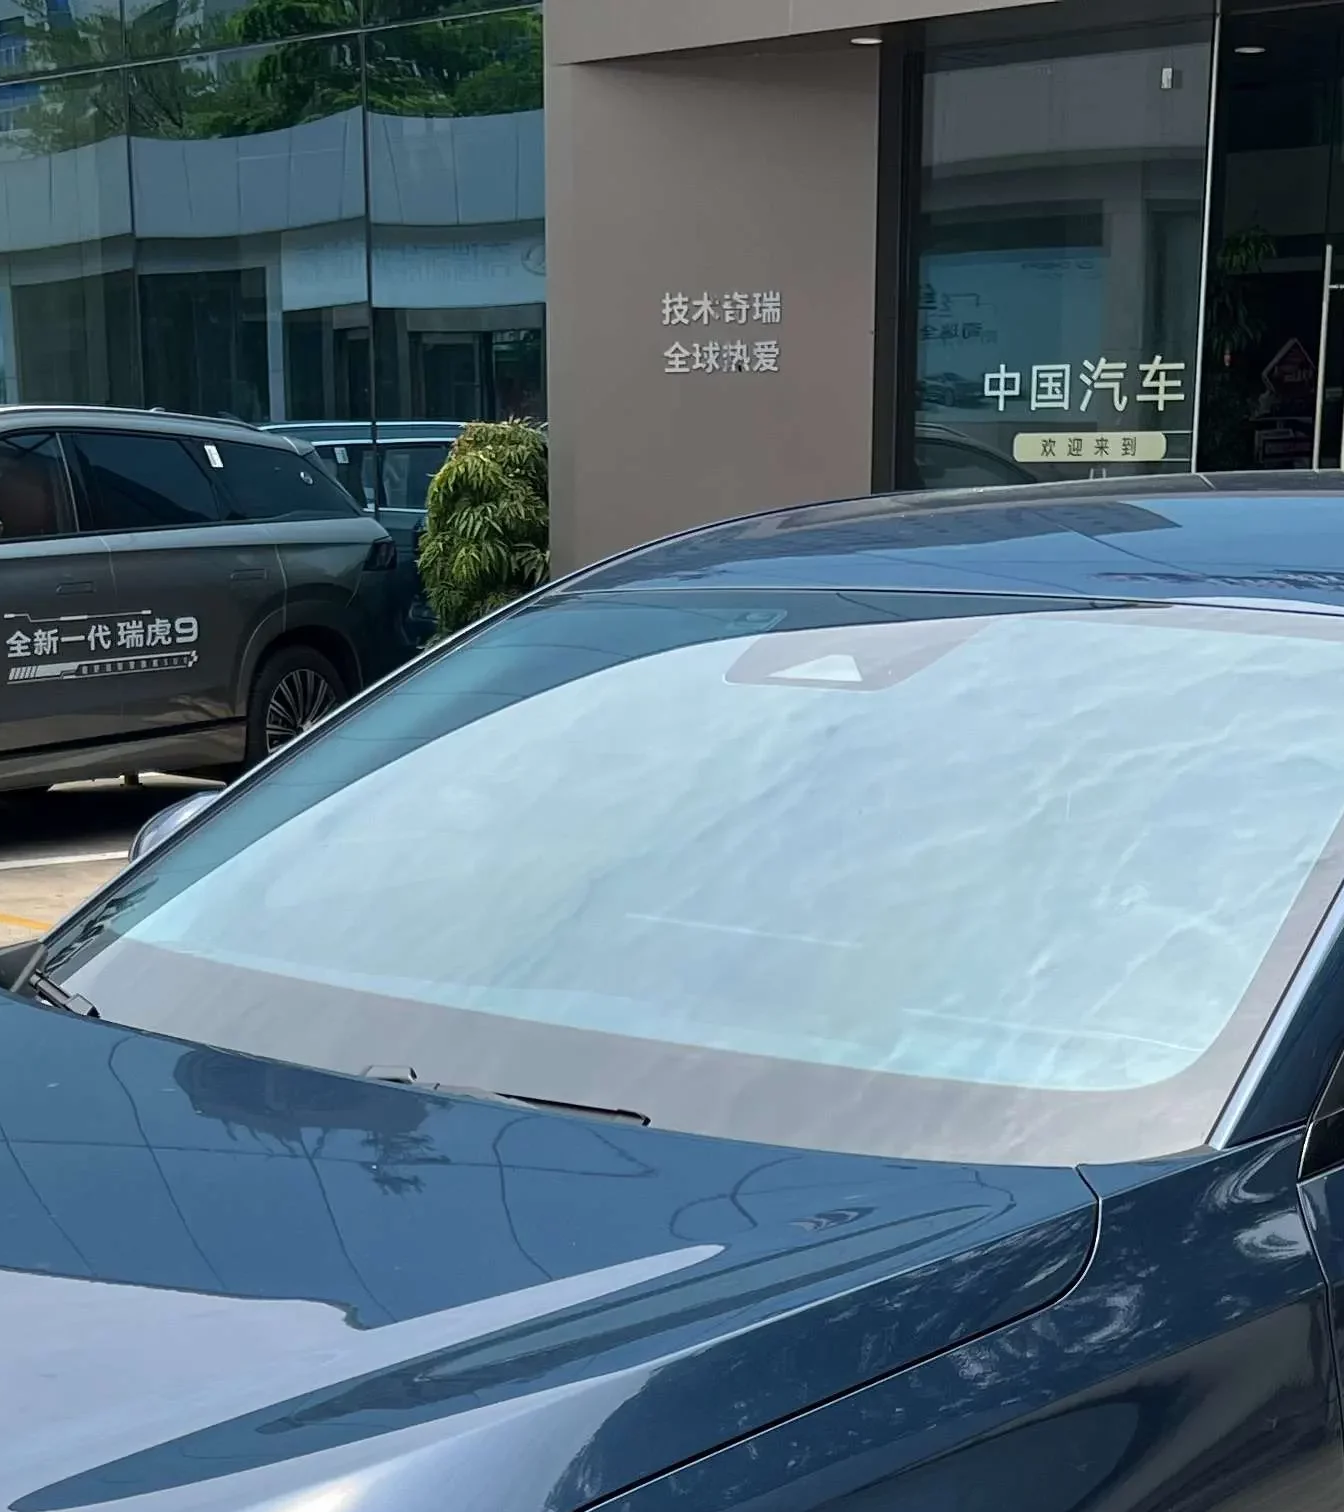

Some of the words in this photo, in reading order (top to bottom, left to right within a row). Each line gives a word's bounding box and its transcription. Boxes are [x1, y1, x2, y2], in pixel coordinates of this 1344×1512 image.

[661, 290, 782, 326] 技术奇瑞
[663, 340, 781, 373] 全球热爱
[983, 355, 1186, 412] 中国汽车
[1040, 436, 1137, 457] 欢迎来到
[6, 624, 112, 658] 全新一代
[117, 616, 198, 649] 瑞虎9
